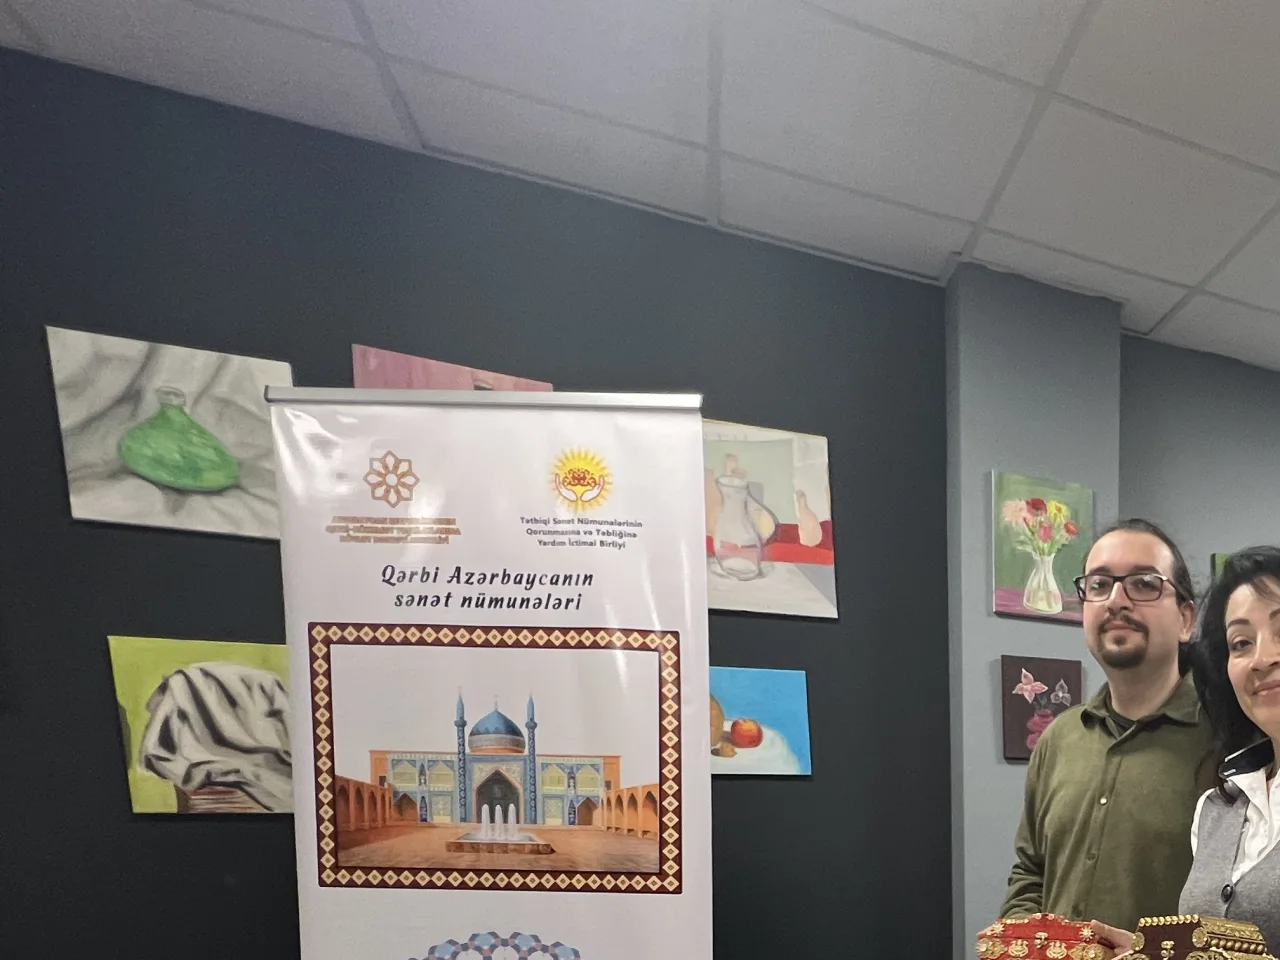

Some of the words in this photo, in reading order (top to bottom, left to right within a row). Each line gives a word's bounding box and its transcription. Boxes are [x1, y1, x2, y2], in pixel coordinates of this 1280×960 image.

[381, 564, 440, 587] Qərbi
[447, 566, 594, 591] Azərbaycanın
[394, 592, 453, 608] sənət
[460, 592, 582, 610] nümunələri
